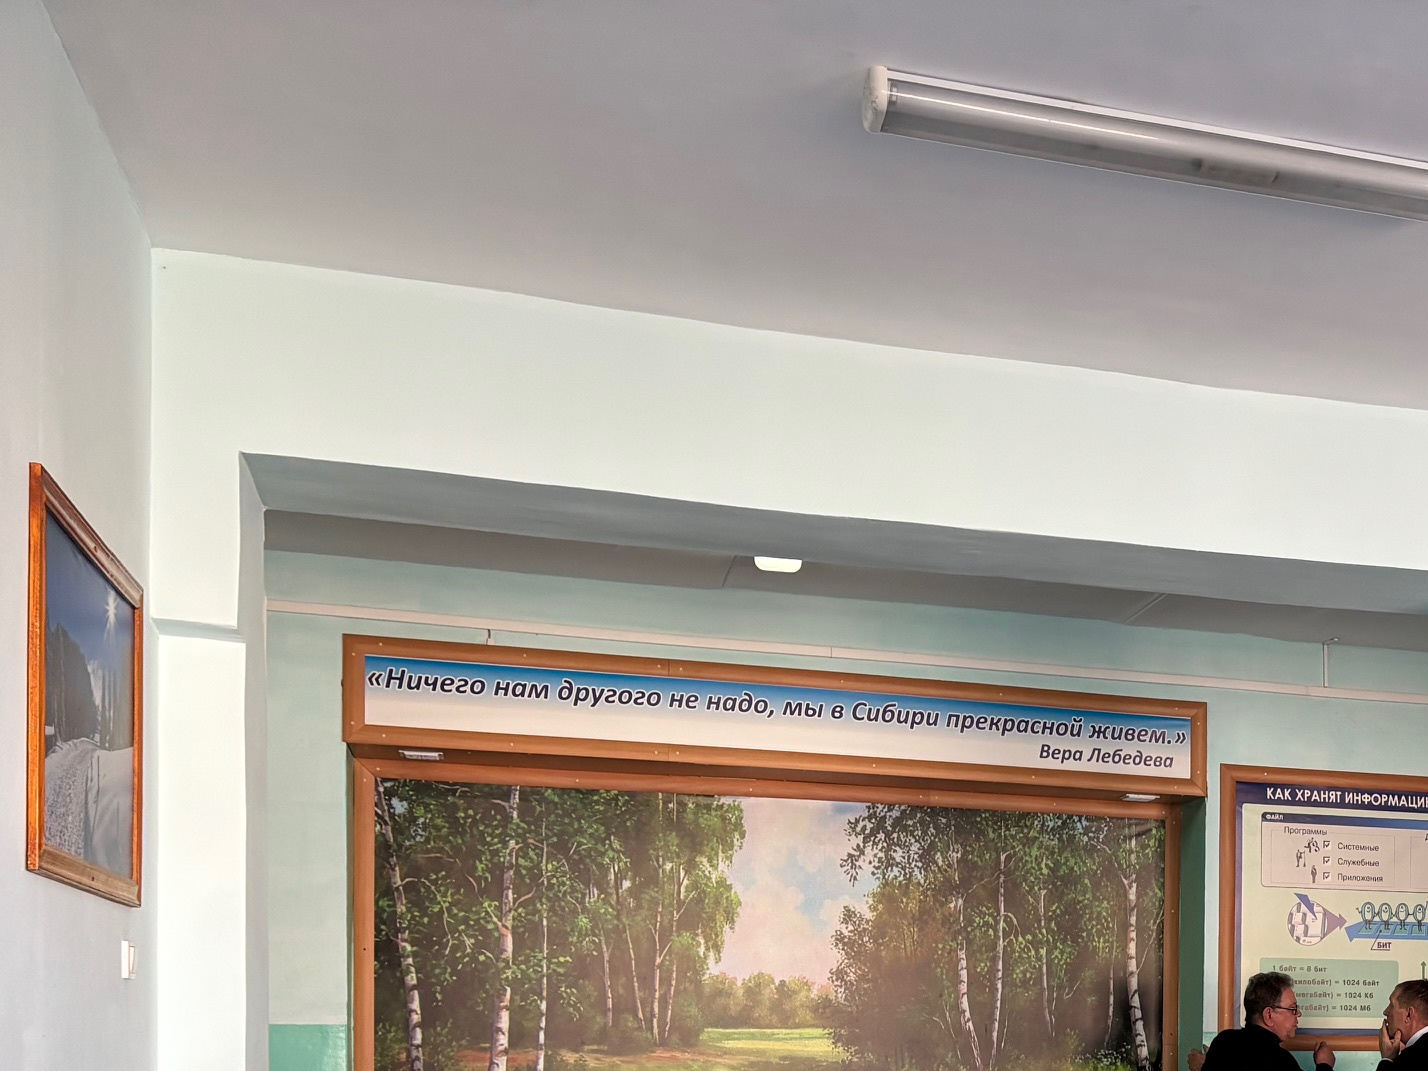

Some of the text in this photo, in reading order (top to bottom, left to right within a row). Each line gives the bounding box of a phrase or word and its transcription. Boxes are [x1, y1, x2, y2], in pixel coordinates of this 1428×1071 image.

[367, 667, 1188, 746] «Ничего нам другого не надо, мы в Сибири прекрасной живем.»
[1039, 743, 1175, 769] Вера Лебедева
[1266, 787, 1292, 801] КАК
[1295, 789, 1341, 804] ХРАНЯТ
[1265, 813, 1284, 821] ФАЙЛ
[1283, 826, 1328, 837] Программы
[1337, 842, 1380, 852] Системные
[1337, 857, 1380, 868] Служебные
[1337, 872, 1384, 883] Приложения
[1363, 979, 1380, 987] байт
